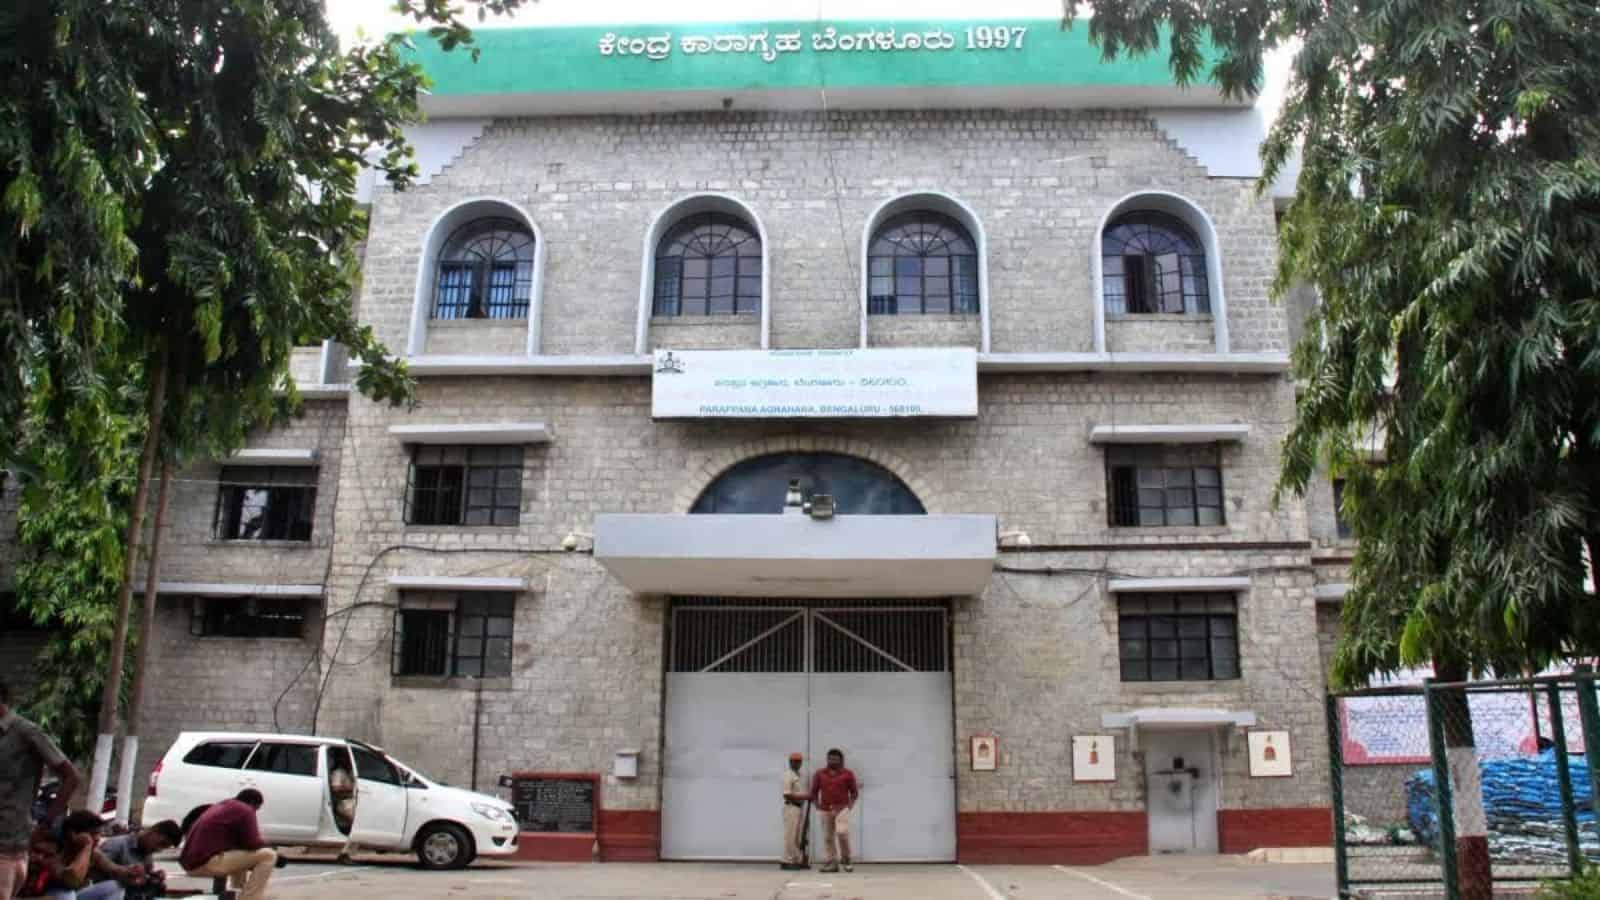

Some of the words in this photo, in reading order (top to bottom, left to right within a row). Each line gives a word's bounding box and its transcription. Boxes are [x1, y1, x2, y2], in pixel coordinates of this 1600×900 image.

[599, 32, 671, 60] ಕೇಂದ್ರ
[680, 30, 802, 62] ಕಾರಾಗೃಹ
[811, 27, 955, 50] ಬೆಂಗಳೂರು
[964, 25, 1027, 49] 1997
